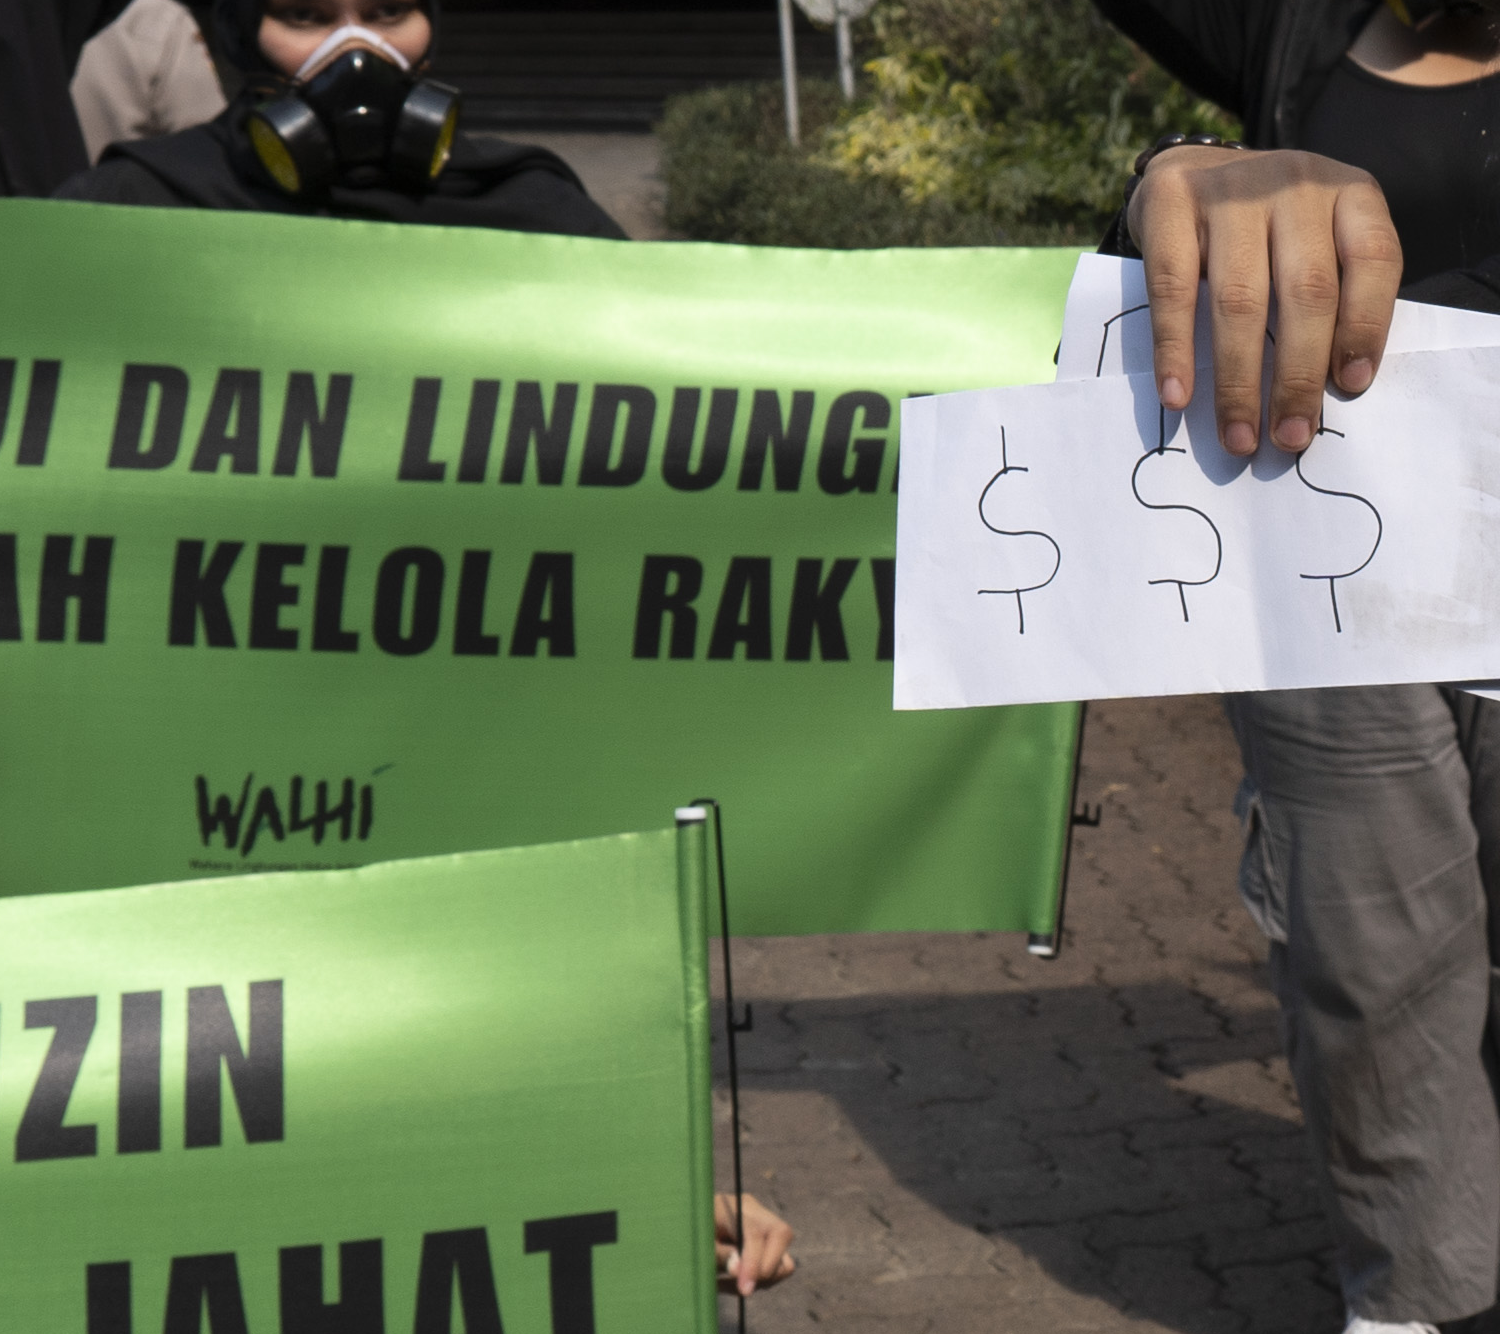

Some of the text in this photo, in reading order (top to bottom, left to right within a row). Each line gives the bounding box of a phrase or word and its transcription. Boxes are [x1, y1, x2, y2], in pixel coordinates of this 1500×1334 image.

[107, 361, 356, 479] DAN
[396, 374, 934, 496] LINDUNG
[165, 538, 580, 660] KELOLA
[194, 772, 375, 857] WALHI
